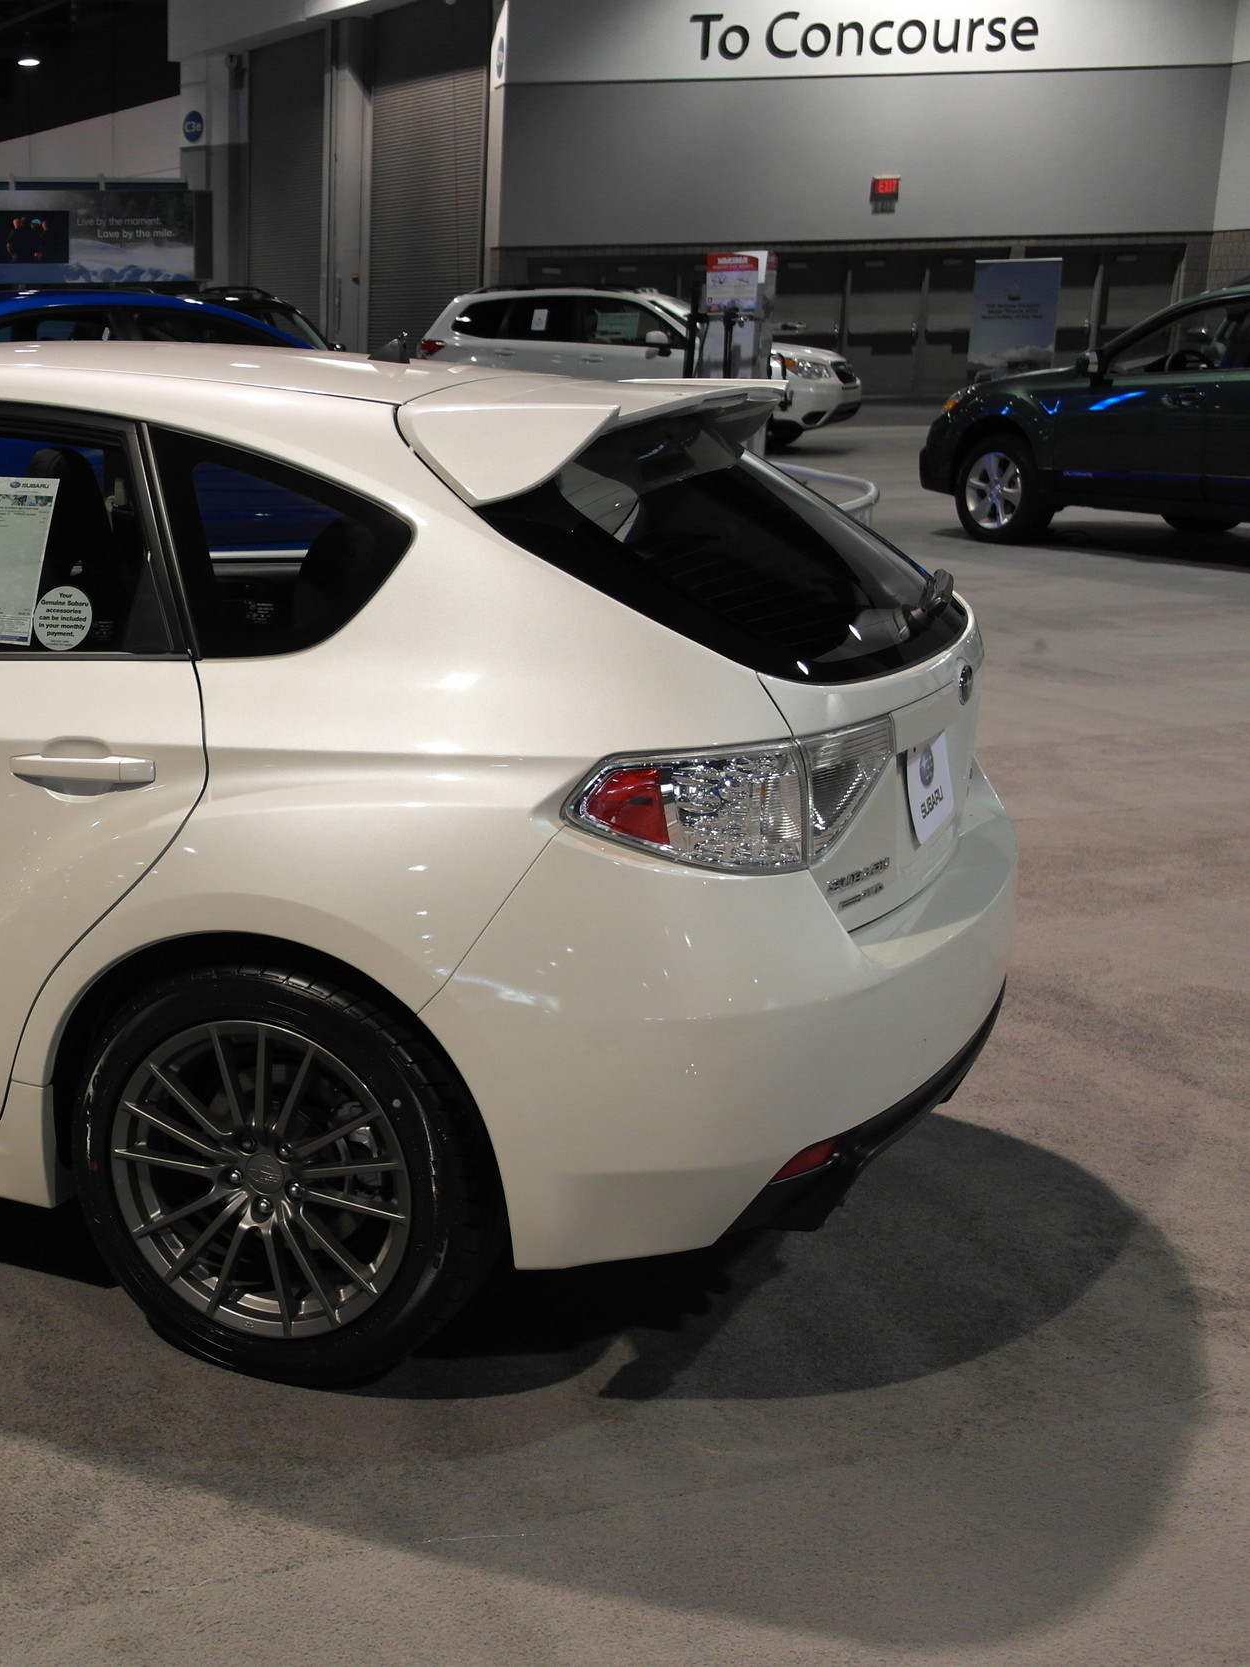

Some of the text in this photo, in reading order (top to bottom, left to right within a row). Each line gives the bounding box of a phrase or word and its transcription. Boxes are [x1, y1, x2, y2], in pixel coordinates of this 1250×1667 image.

[689, 11, 1039, 61] To Concourse
[878, 179, 898, 193] EXIT
[76, 217, 162, 227] Live by the moment.
[97, 228, 175, 240] Love by the mile.
[920, 785, 944, 819] SUBARU
